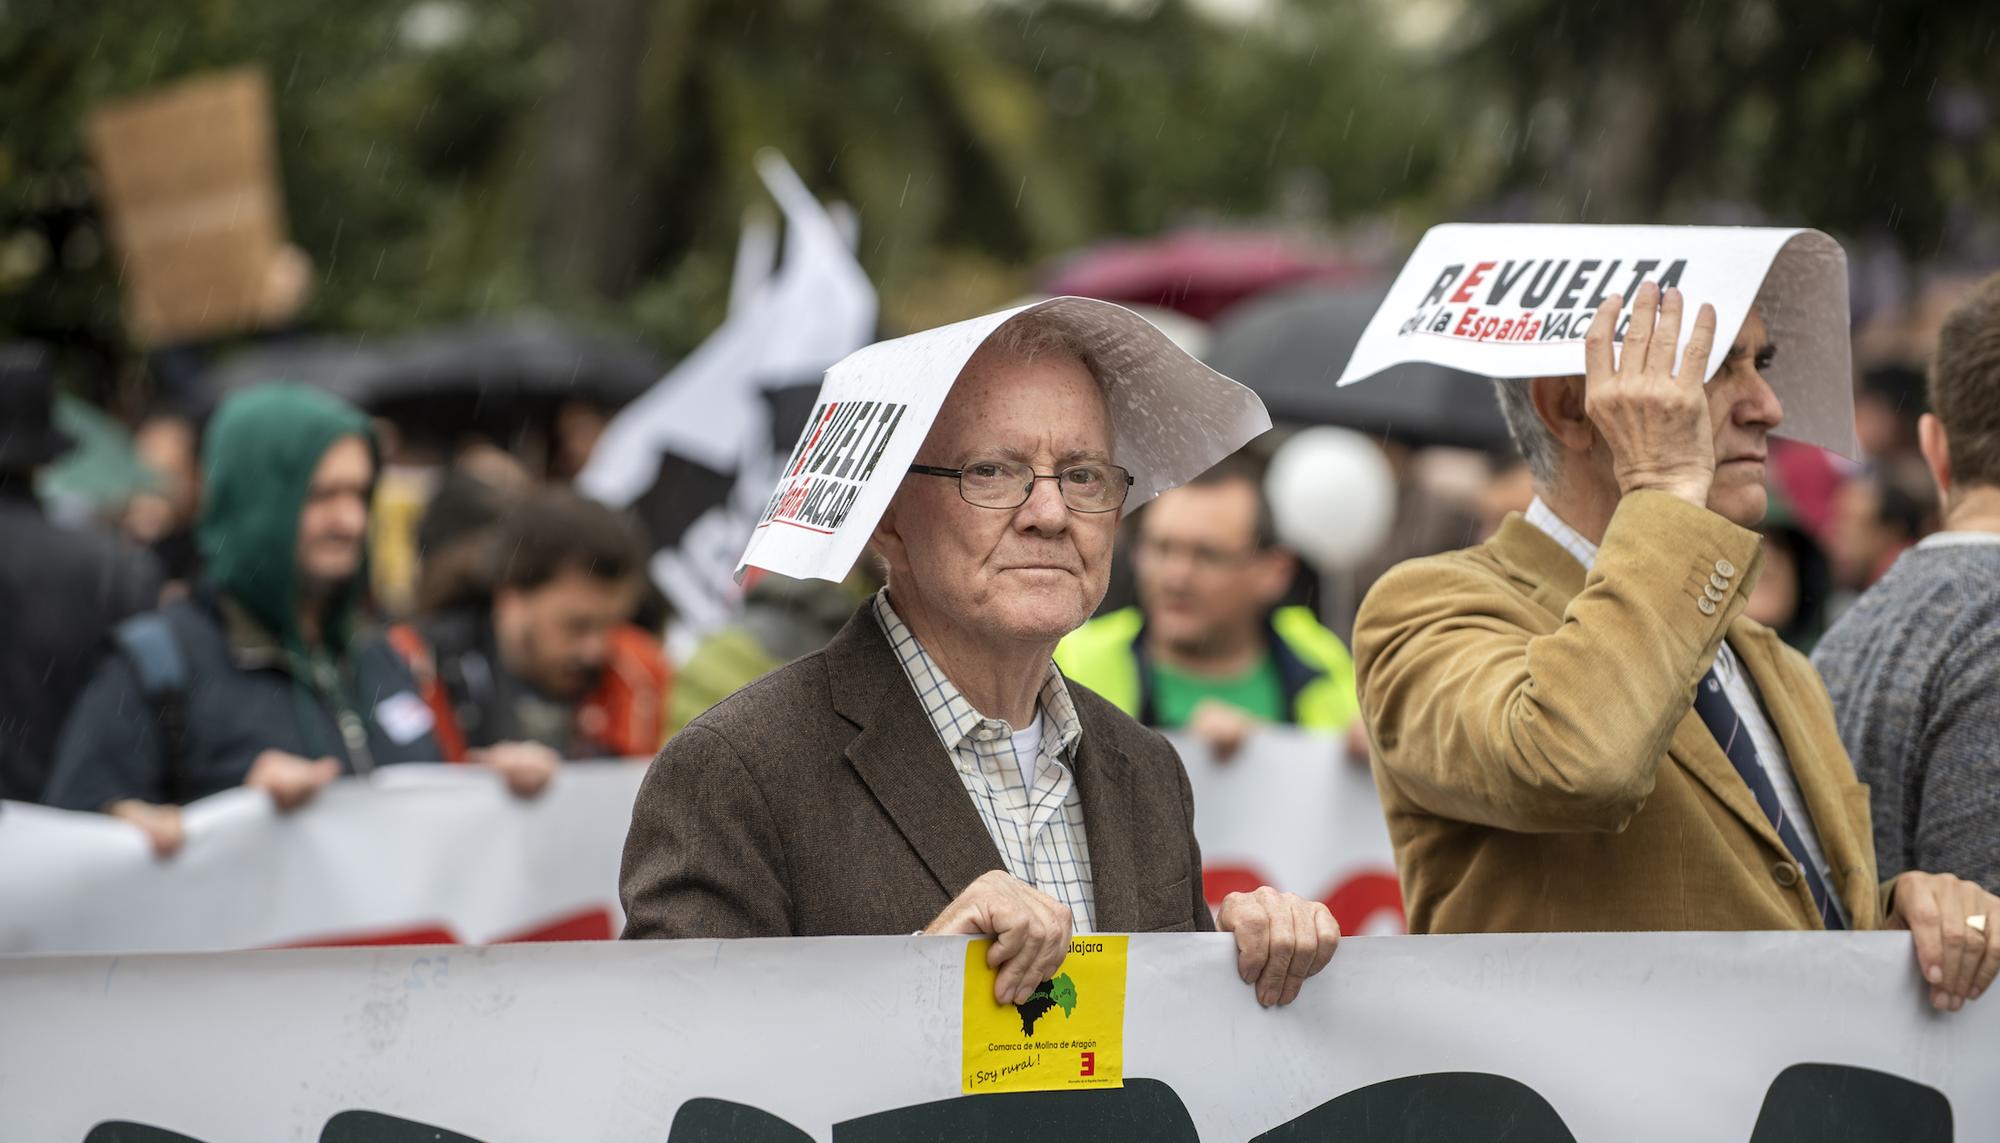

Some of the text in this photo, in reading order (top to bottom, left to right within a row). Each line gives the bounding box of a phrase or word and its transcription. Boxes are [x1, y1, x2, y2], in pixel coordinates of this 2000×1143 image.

[1417, 259, 1688, 309] REVUELTA
[1426, 307, 1453, 333] la
[783, 401, 908, 481] REVUELTA
[1067, 941, 1103, 956] alajara
[988, 1039, 1097, 1052] Comarca de Molina de Aragón
